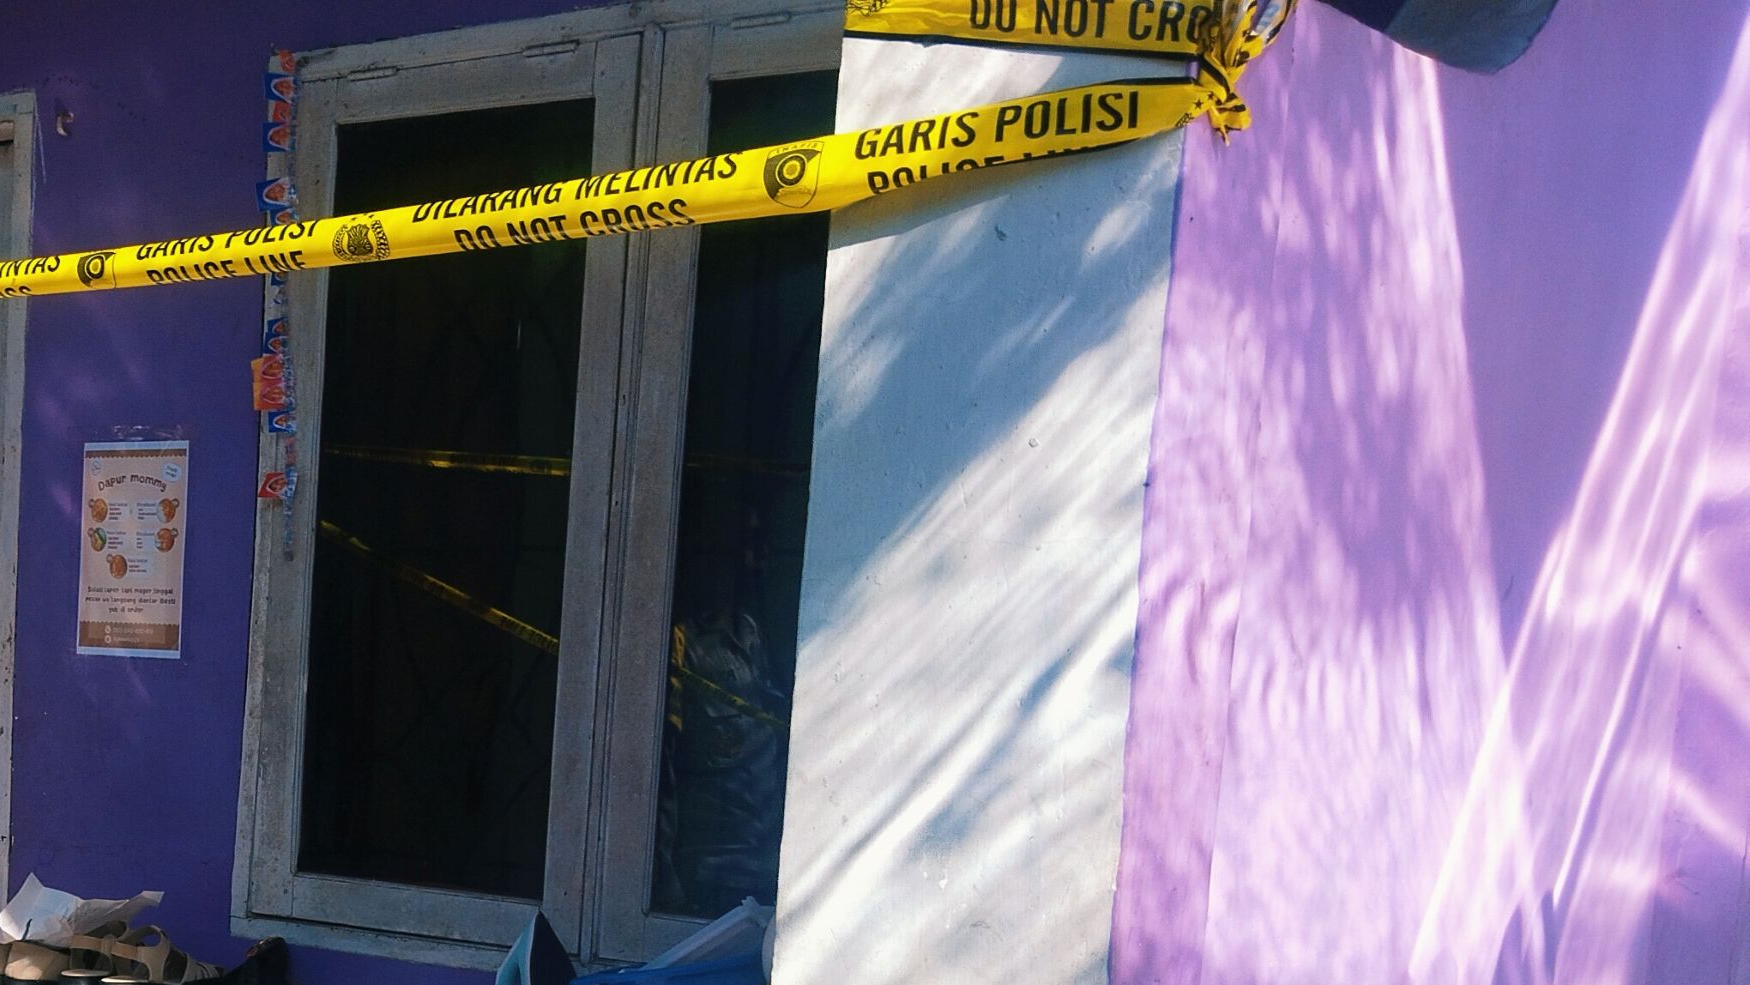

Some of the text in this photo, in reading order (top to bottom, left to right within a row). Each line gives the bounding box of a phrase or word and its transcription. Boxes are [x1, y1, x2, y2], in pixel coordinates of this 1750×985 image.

[969, 0, 1214, 44] DO NOT CRO
[855, 91, 1140, 160] GARIS POLISI
[412, 152, 741, 223] DILARANG MELINTAS
[135, 220, 320, 261] GARIS POLISI
[453, 198, 697, 252] DO NOT CROSS
[146, 249, 308, 285] POLICE LINE
